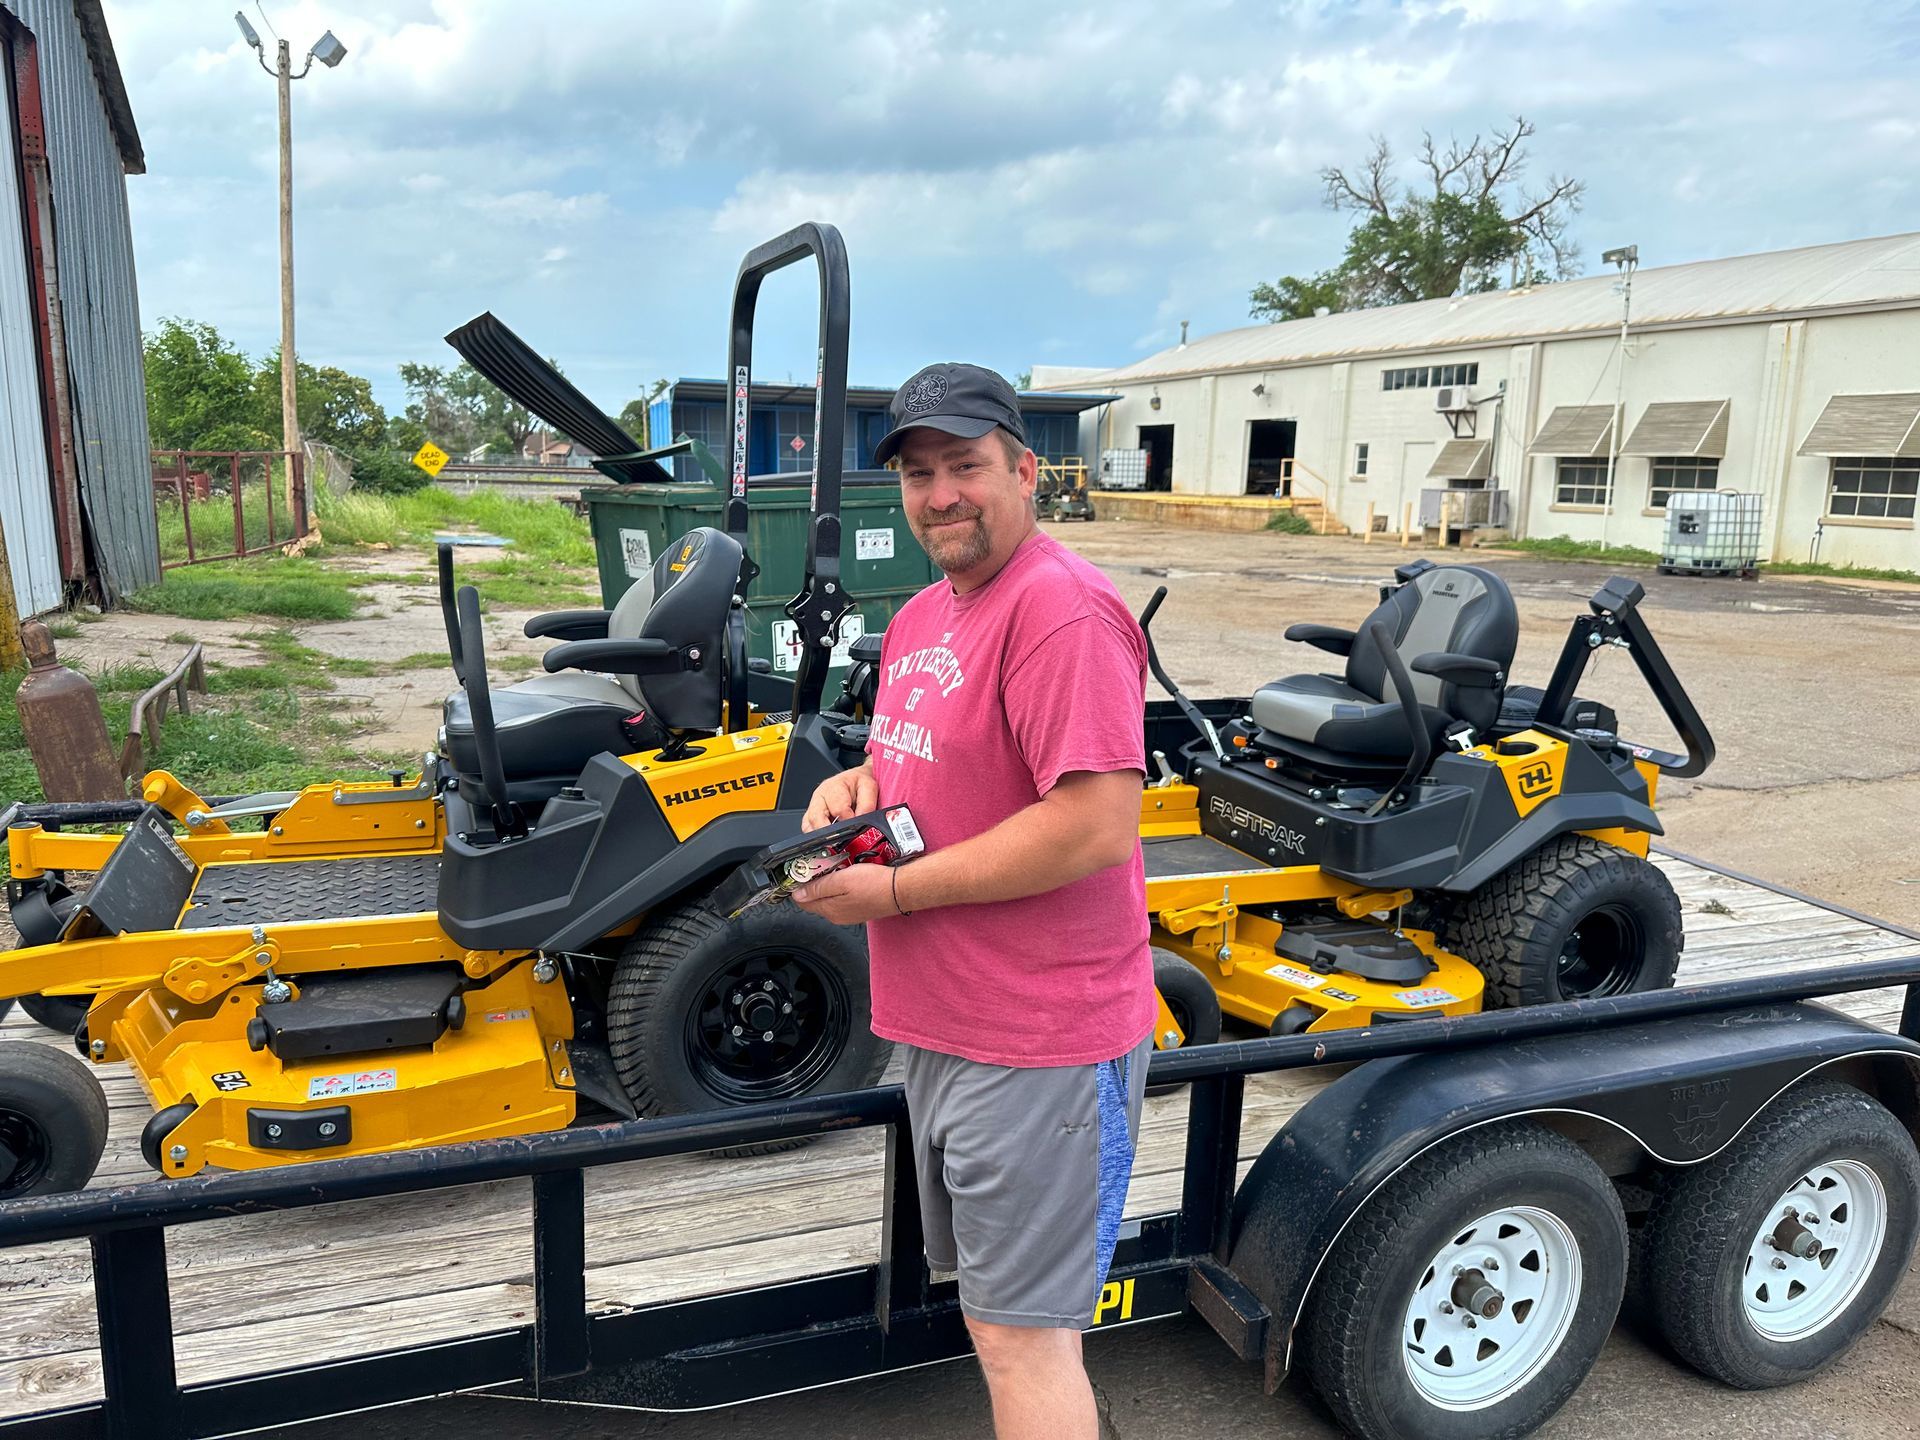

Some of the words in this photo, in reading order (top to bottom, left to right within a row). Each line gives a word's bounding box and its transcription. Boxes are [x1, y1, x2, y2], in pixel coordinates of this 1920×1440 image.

[421, 451, 440, 459] DEAD
[905, 687, 925, 711] OF
[663, 771, 775, 807] HUSTLER
[1210, 796, 1306, 855] FASTRAK
[1321, 987, 1360, 1002] 54
[212, 1072, 251, 1092] 54
[1093, 1278, 1136, 1325] PI
